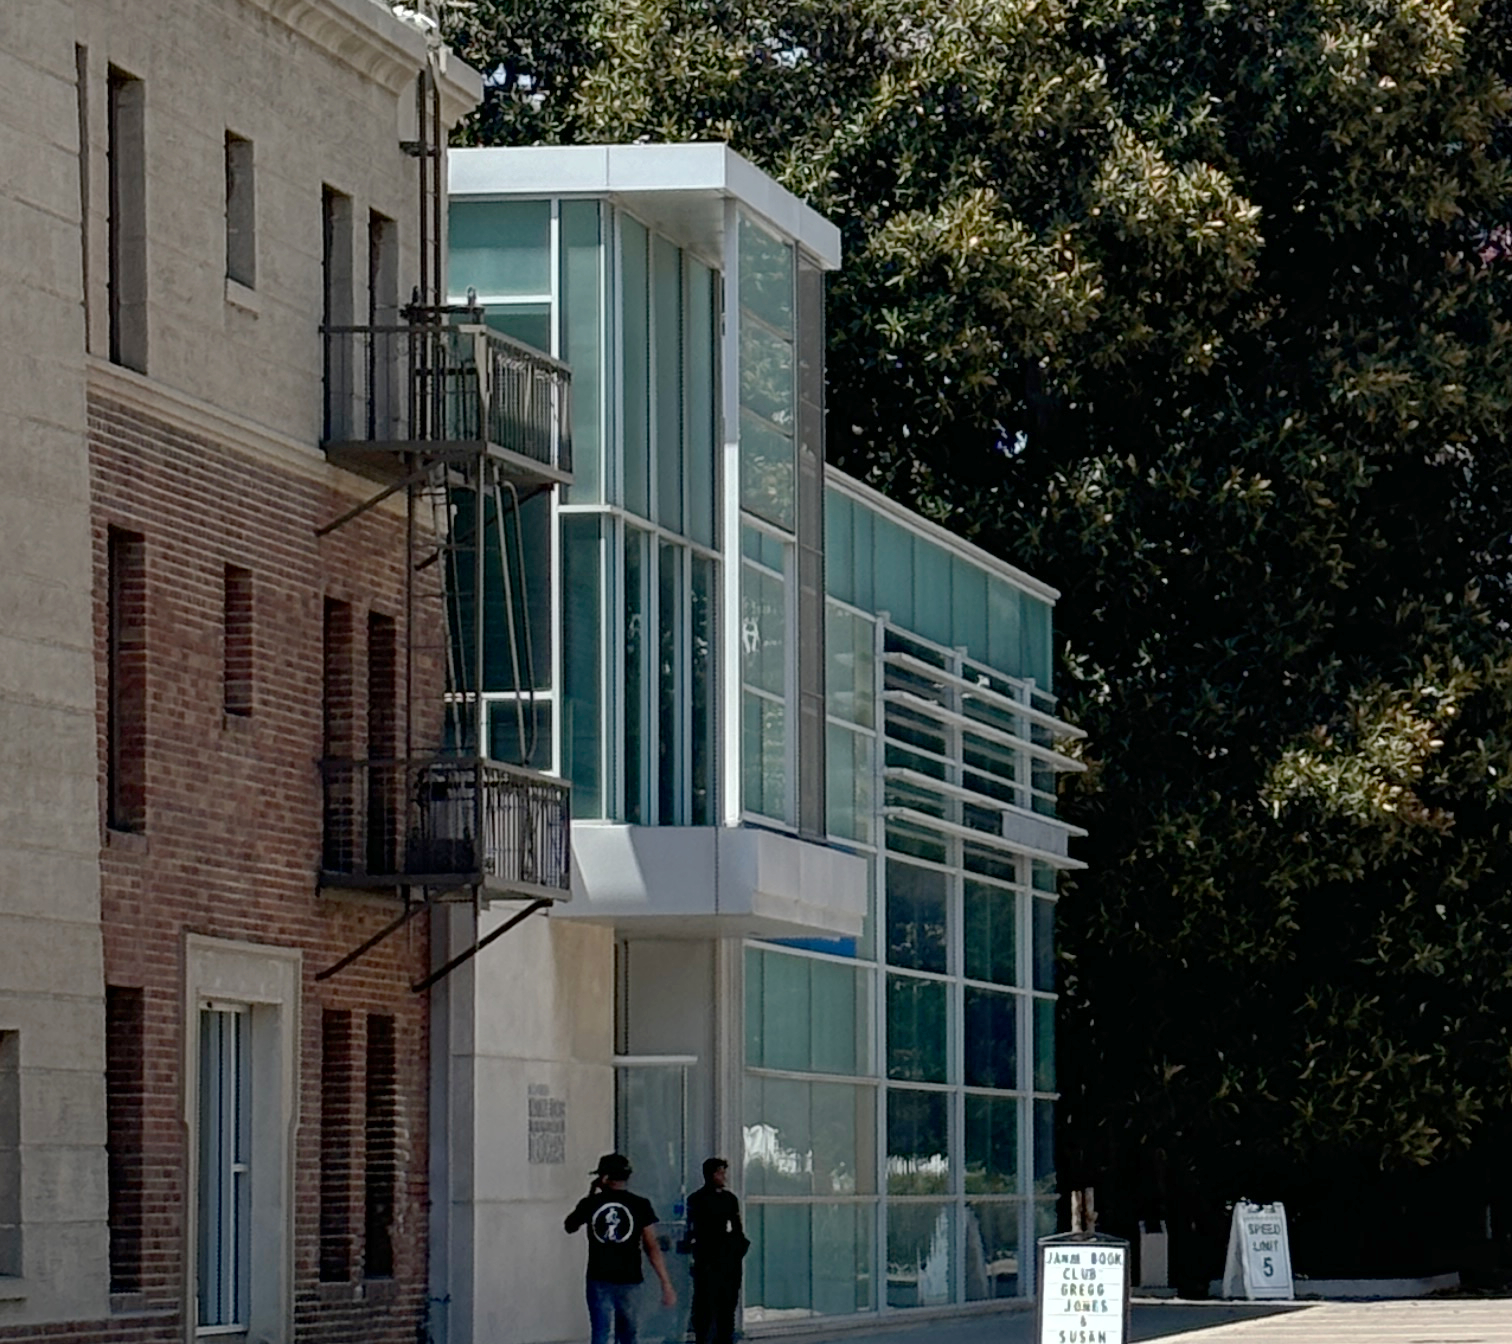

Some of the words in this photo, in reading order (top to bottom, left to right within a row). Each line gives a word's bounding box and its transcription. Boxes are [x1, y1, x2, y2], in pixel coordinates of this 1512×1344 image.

[1248, 1223, 1281, 1235] SPEED
[1091, 1252, 1122, 1265] BOOK
[1263, 1257, 1274, 1277] 5
[1061, 1283, 1104, 1296] GREGG
[1064, 1299, 1108, 1312] JONES
[1080, 1315, 1087, 1327] &
[1059, 1330, 1106, 1343] SUSAN
